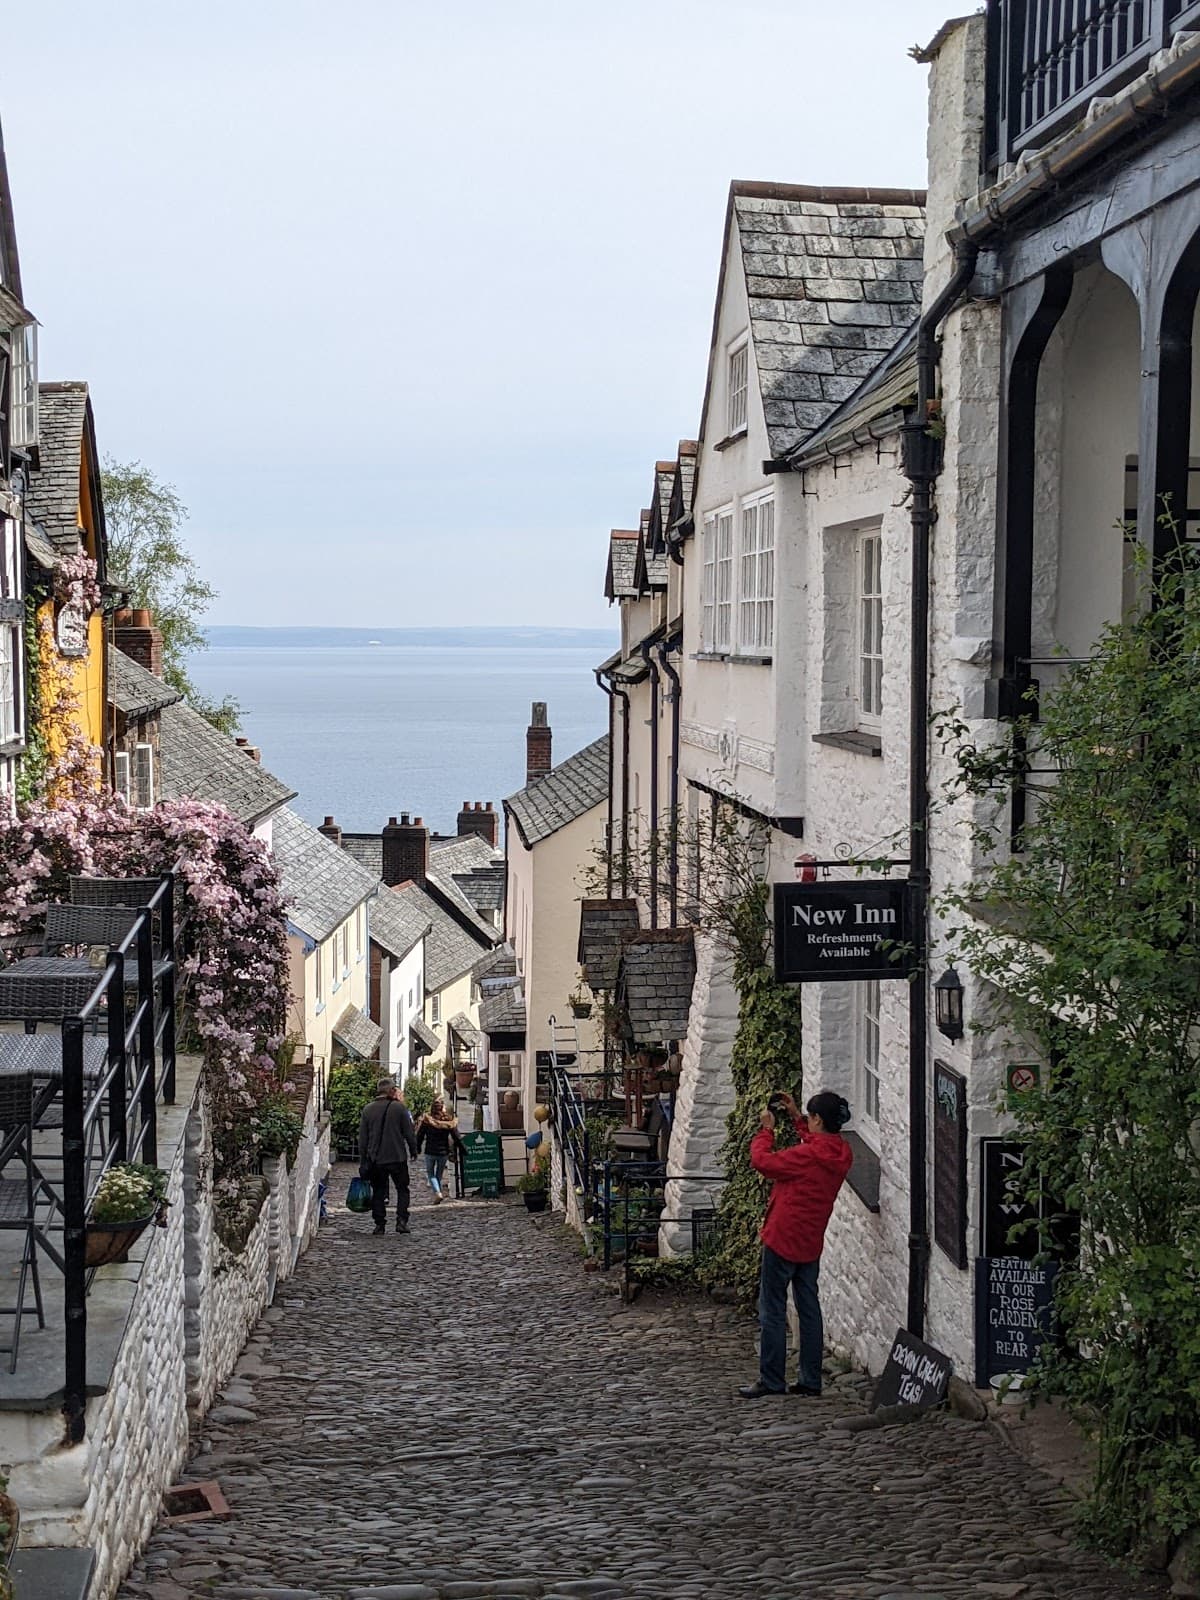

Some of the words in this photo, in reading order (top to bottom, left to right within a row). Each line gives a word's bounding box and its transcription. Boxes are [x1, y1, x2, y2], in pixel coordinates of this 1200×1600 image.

[792, 905, 846, 926] New
[853, 903, 896, 924] Inn
[807, 933, 882, 944] Refreshments
[819, 947, 871, 958] Available
[989, 1258, 1040, 1271] SEATIN
[989, 1270, 1046, 1285] AVAILABLE
[990, 1283, 1007, 1295] IN
[1012, 1283, 1036, 1298] OUR
[1000, 1295, 1035, 1312] ROSE
[989, 1308, 1038, 1329] GARDEN
[1008, 1330, 1025, 1342] TO
[995, 1340, 1028, 1358] REAR
[893, 1343, 921, 1374] DEVON
[917, 1355, 946, 1394] CREAM
